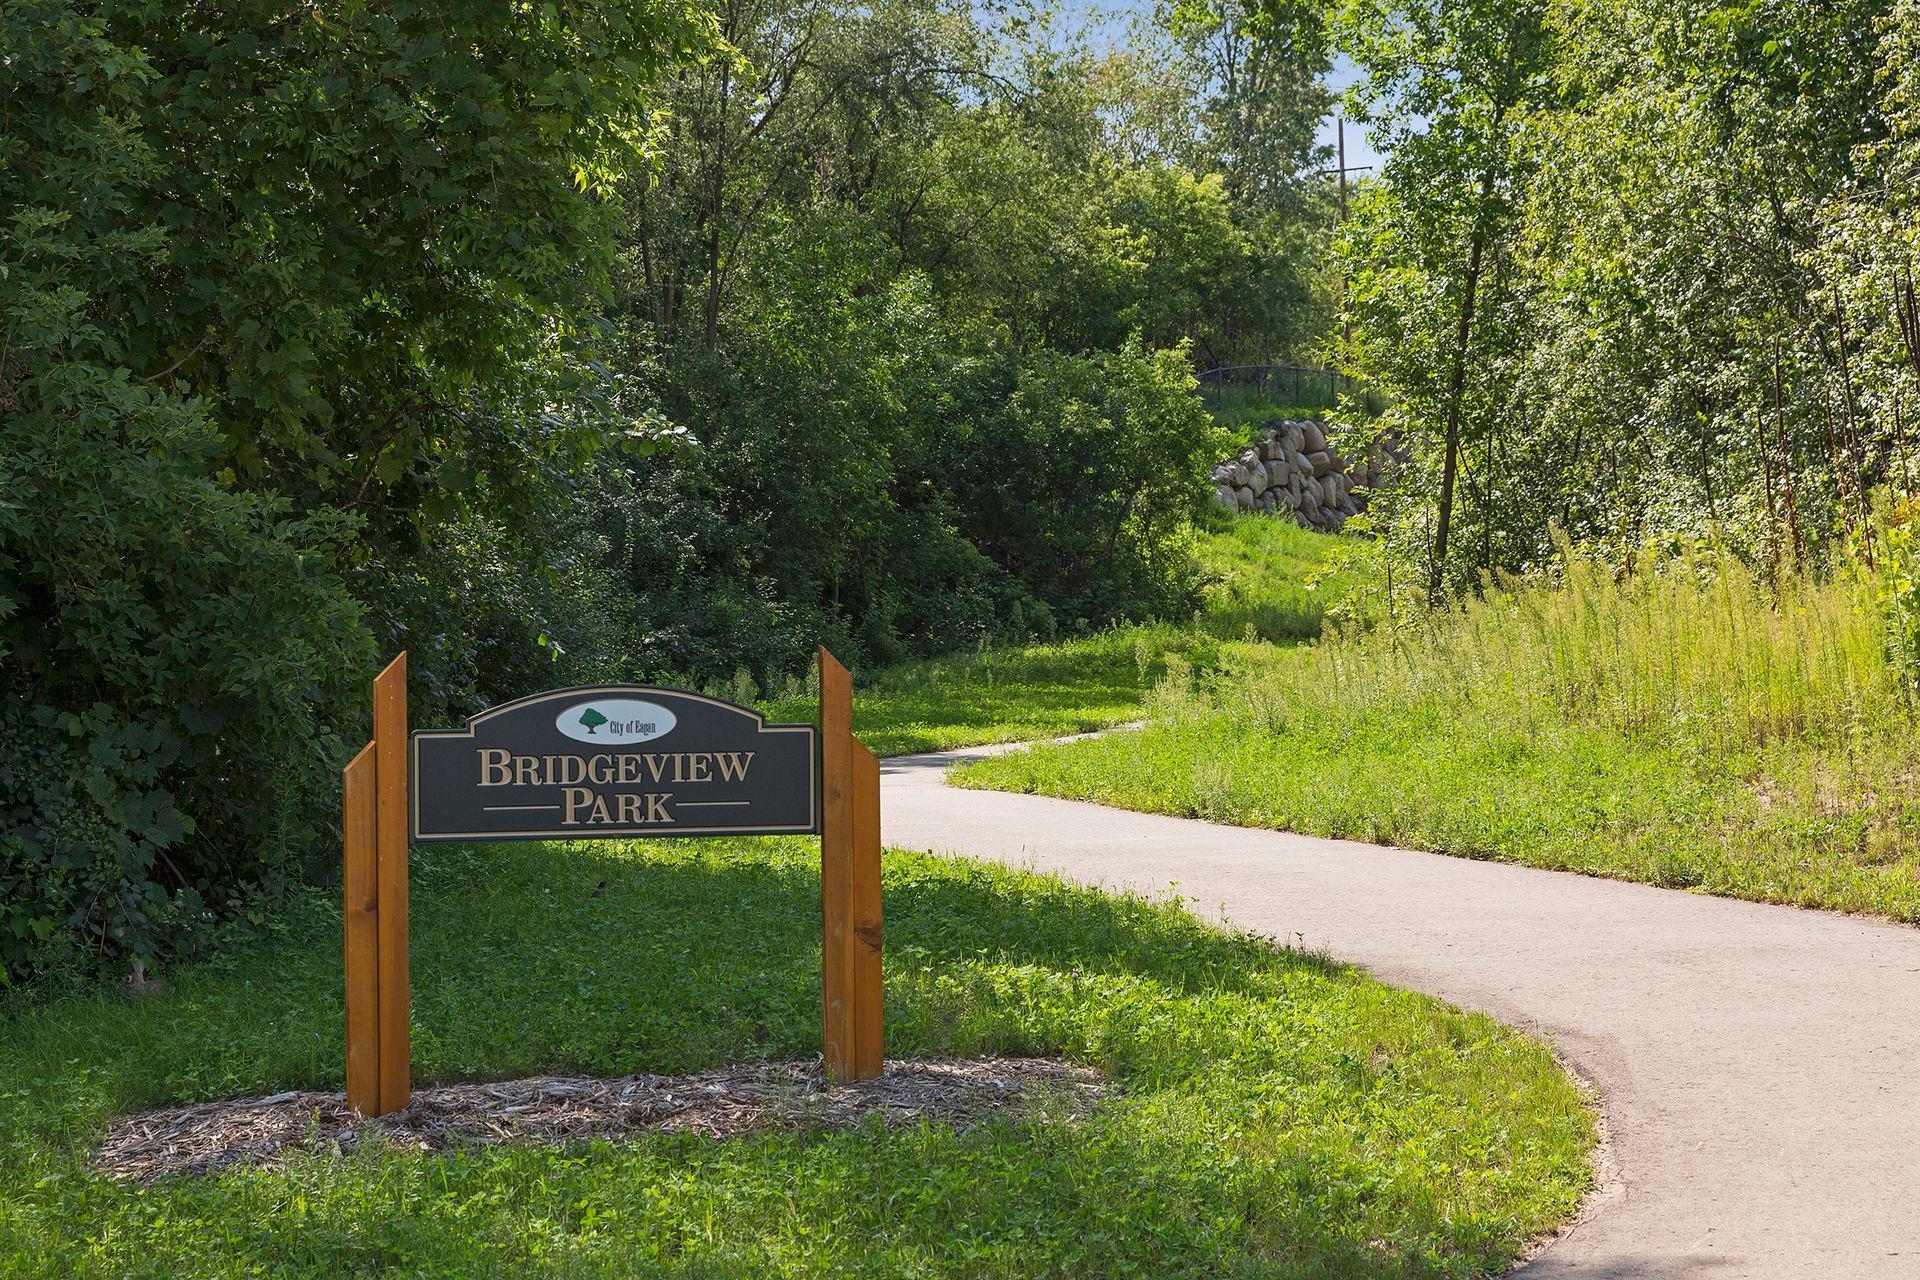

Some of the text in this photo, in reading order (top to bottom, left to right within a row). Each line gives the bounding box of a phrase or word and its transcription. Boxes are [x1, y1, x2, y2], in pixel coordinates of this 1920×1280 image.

[610, 720, 656, 736] City of Eagan
[477, 748, 755, 787] BRIDGEVIEW
[561, 787, 675, 825] PARK
